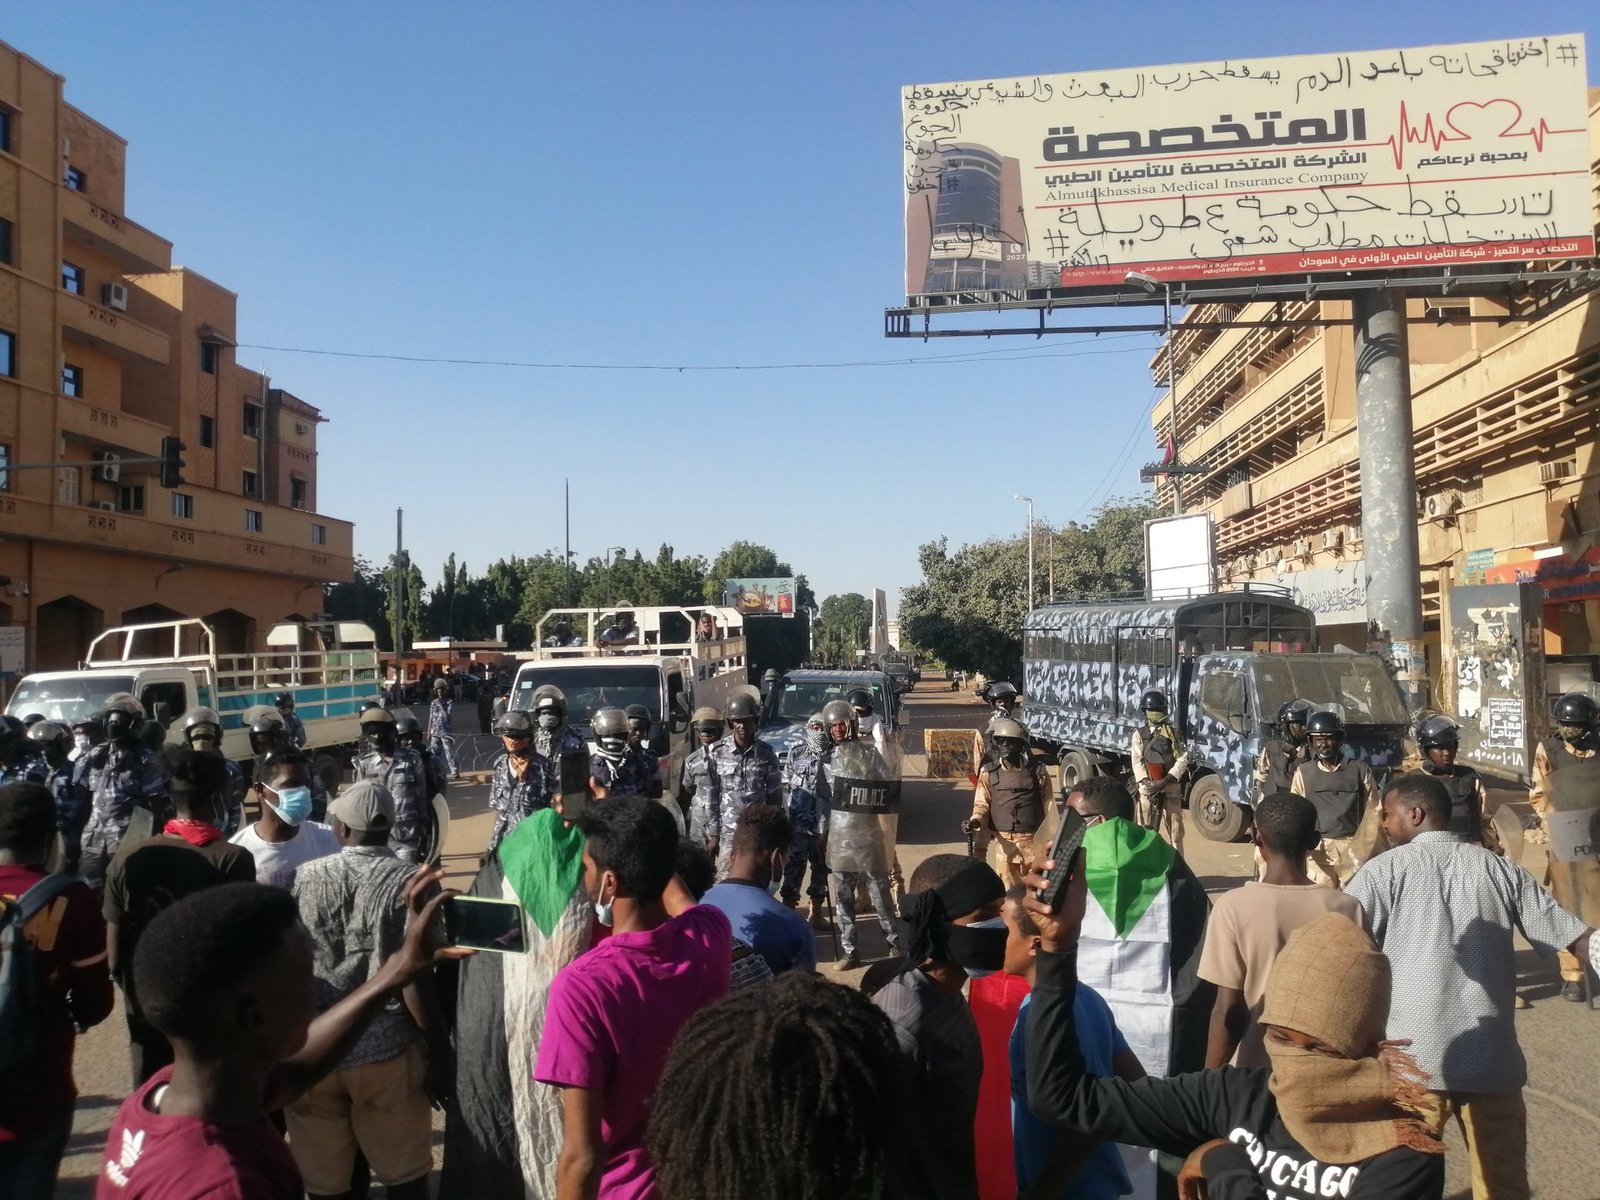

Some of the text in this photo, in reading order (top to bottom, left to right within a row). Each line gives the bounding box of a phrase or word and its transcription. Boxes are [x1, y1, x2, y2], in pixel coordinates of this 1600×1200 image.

[1042, 107, 1367, 162] المتخصصة
[1417, 150, 1528, 169] بمحبة نرعاكم
[1045, 149, 1367, 188] الشركة المتخصصة للتأمين الطبي
[1045, 170, 1369, 202] Almutakhassisa Medical Insurance Company
[1392, 250, 1423, 262] الطبي
[1424, 248, 1457, 260] التأمين
[1459, 247, 1486, 258] شركة
[1493, 245, 1518, 257] التميز
[1520, 245, 1535, 256] سر
[1006, 254, 1026, 262] 2627
[1299, 254, 1338, 267] السودان
[1339, 255, 1357, 265] في
[1359, 252, 1390, 264] الأولى
[850, 786, 887, 806] POLICE
